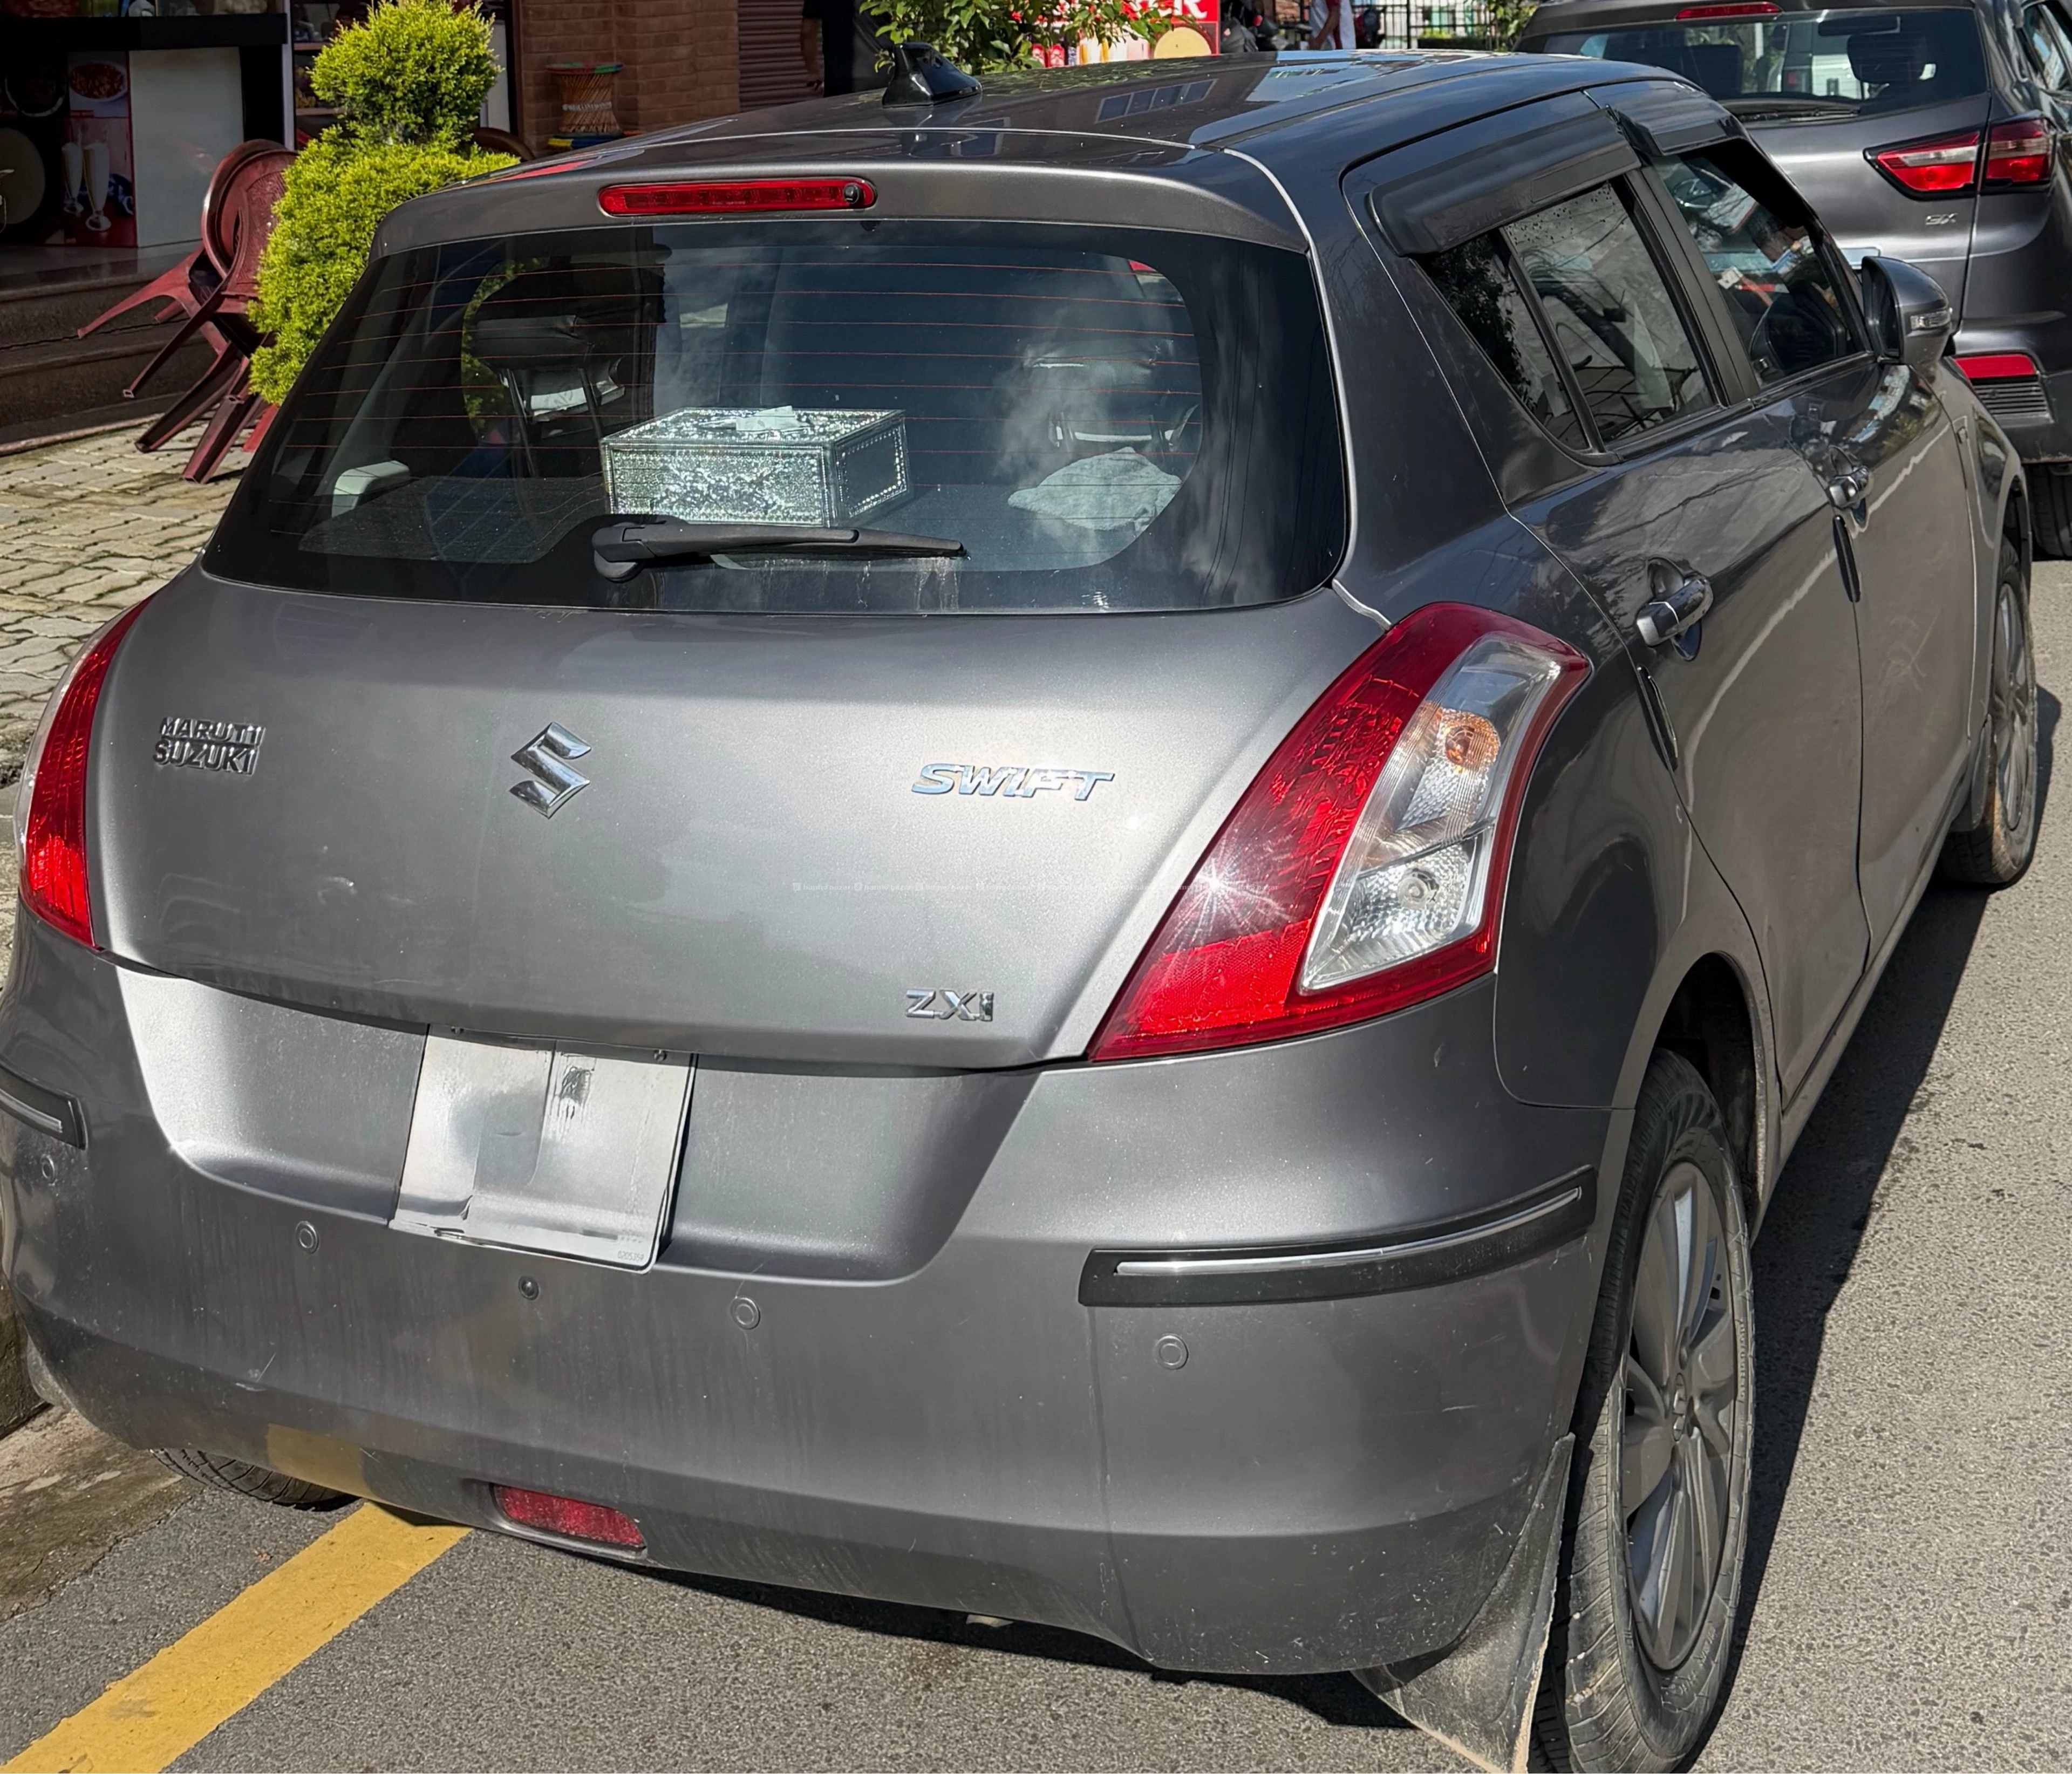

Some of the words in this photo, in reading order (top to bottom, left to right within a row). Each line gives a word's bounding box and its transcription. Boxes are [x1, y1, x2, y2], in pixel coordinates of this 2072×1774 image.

[160, 717, 266, 746] MARUTI
[153, 740, 260, 776] SUZUKI
[911, 763, 1116, 801] SWIFT
